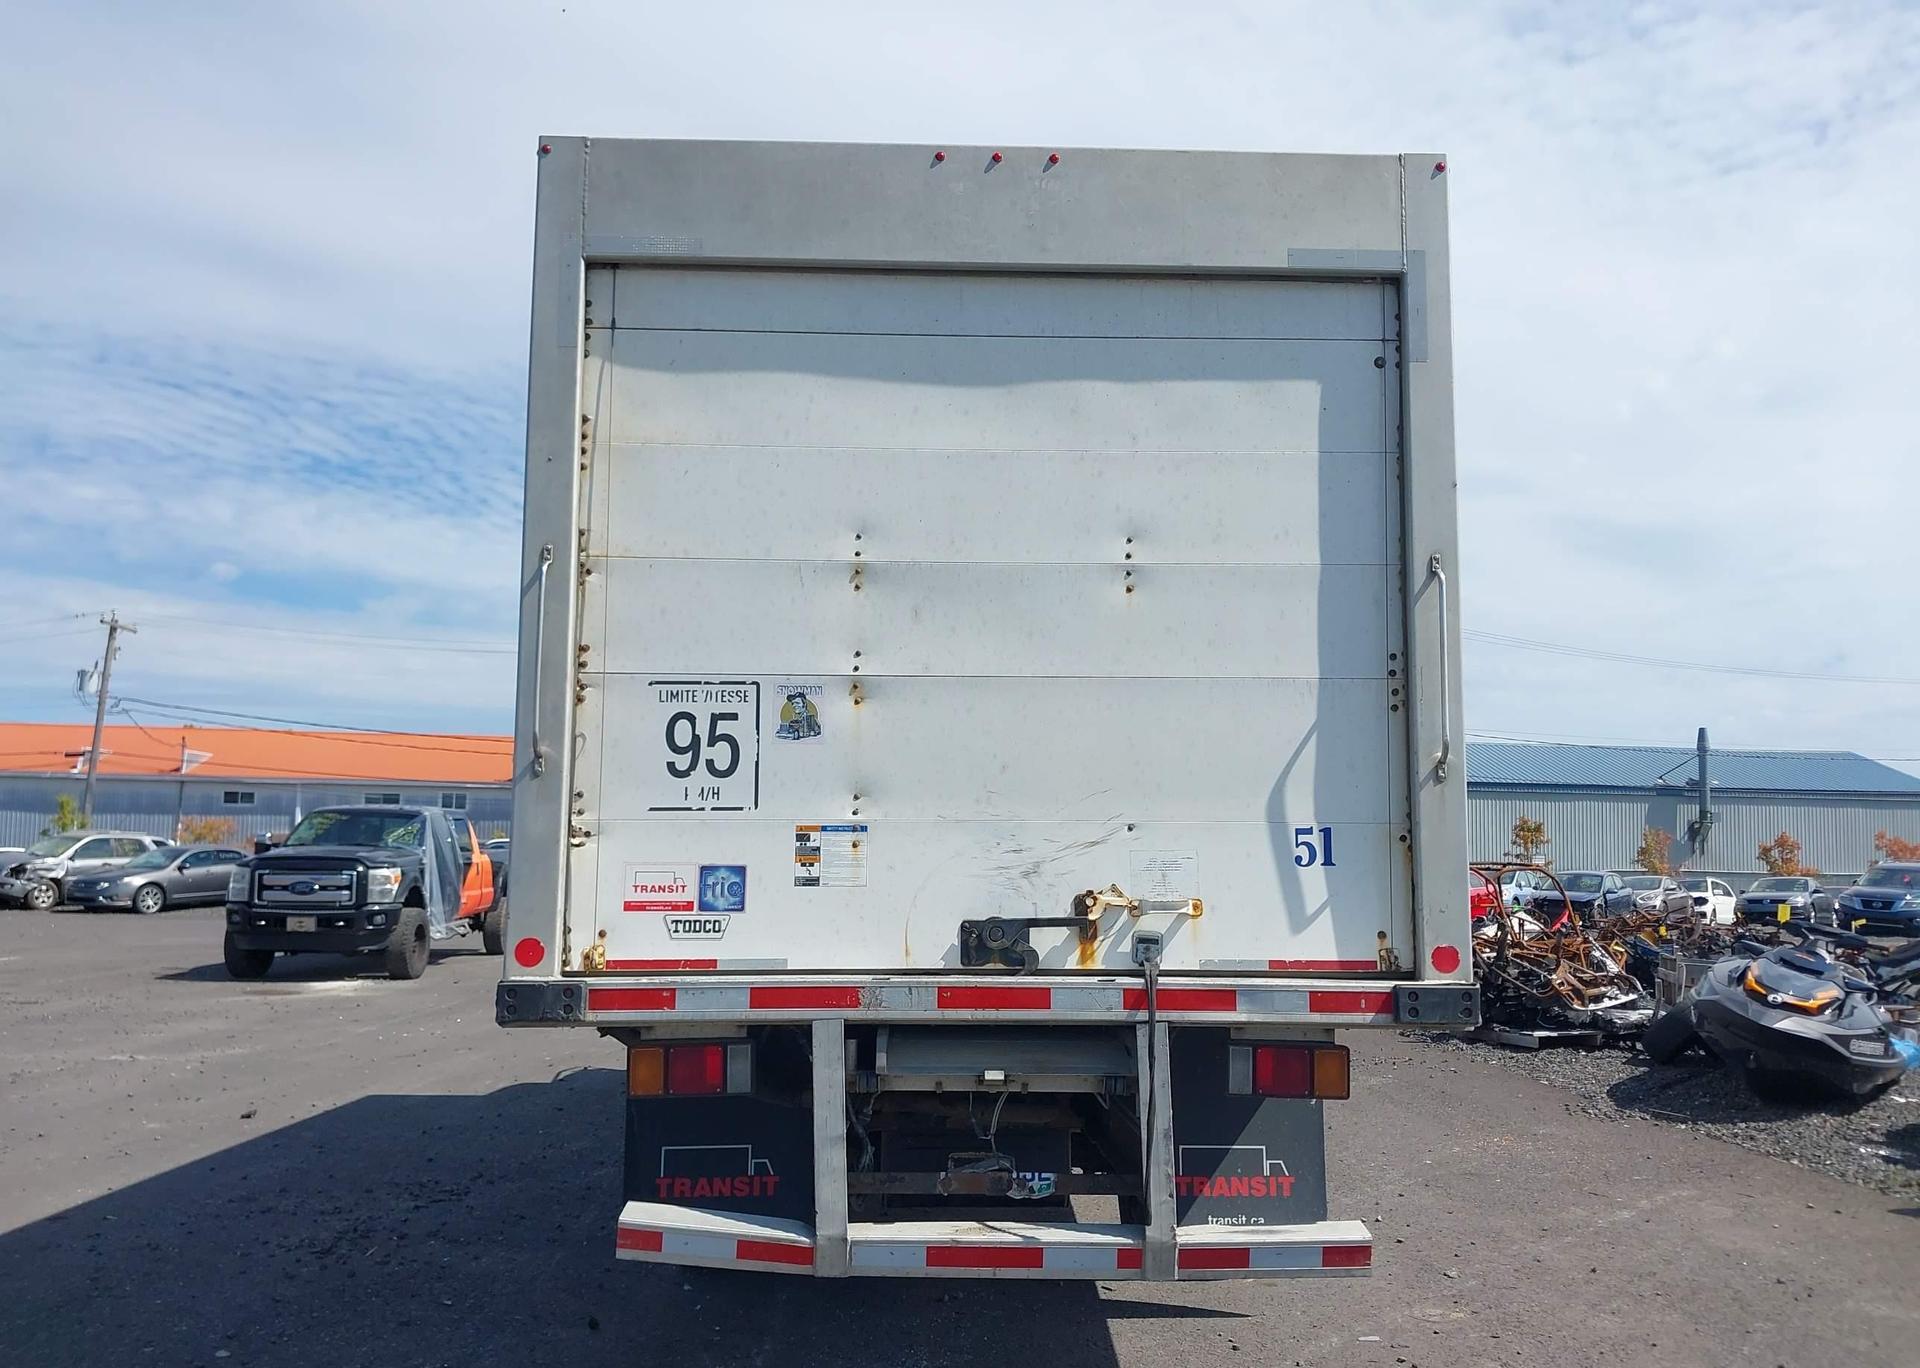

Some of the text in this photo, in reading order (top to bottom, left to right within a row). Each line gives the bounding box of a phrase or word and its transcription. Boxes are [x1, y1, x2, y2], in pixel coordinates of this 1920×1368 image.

[659, 690, 698, 703] LIMITE
[665, 711, 740, 778] 95
[1294, 826, 1336, 867] 51
[632, 885, 687, 893] TRANSIT
[671, 919, 721, 933] TODCO
[656, 1176, 779, 1198] TRANSIT
[1175, 1175, 1295, 1198] TRANSIT
[1208, 1215, 1264, 1225] transitca
